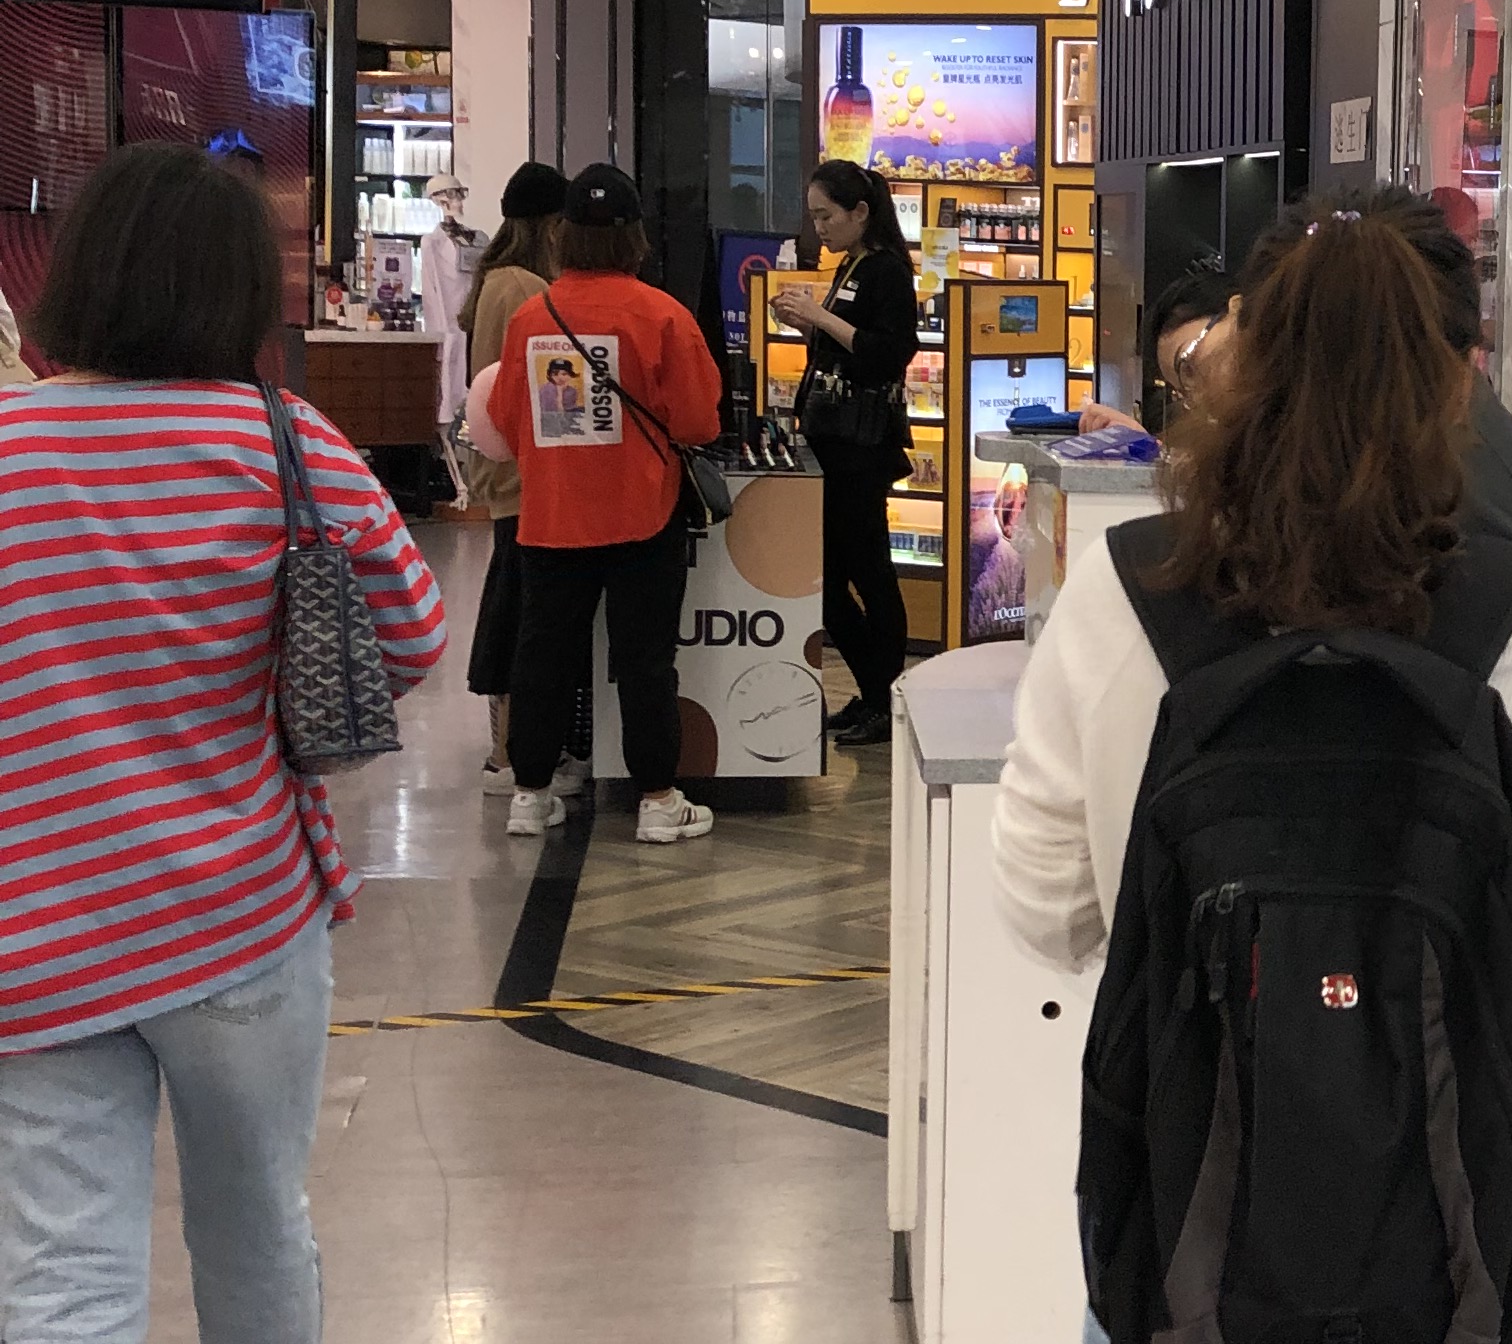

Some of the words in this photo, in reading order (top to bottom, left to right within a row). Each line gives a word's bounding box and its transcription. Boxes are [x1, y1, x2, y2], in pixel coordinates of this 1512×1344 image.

[932, 54, 958, 64] WAKE
[959, 55, 972, 64] UP
[972, 55, 984, 64] TO
[985, 55, 1012, 64] RESET
[1013, 55, 1034, 65] SKIN
[532, 341, 560, 352] ISSUE
